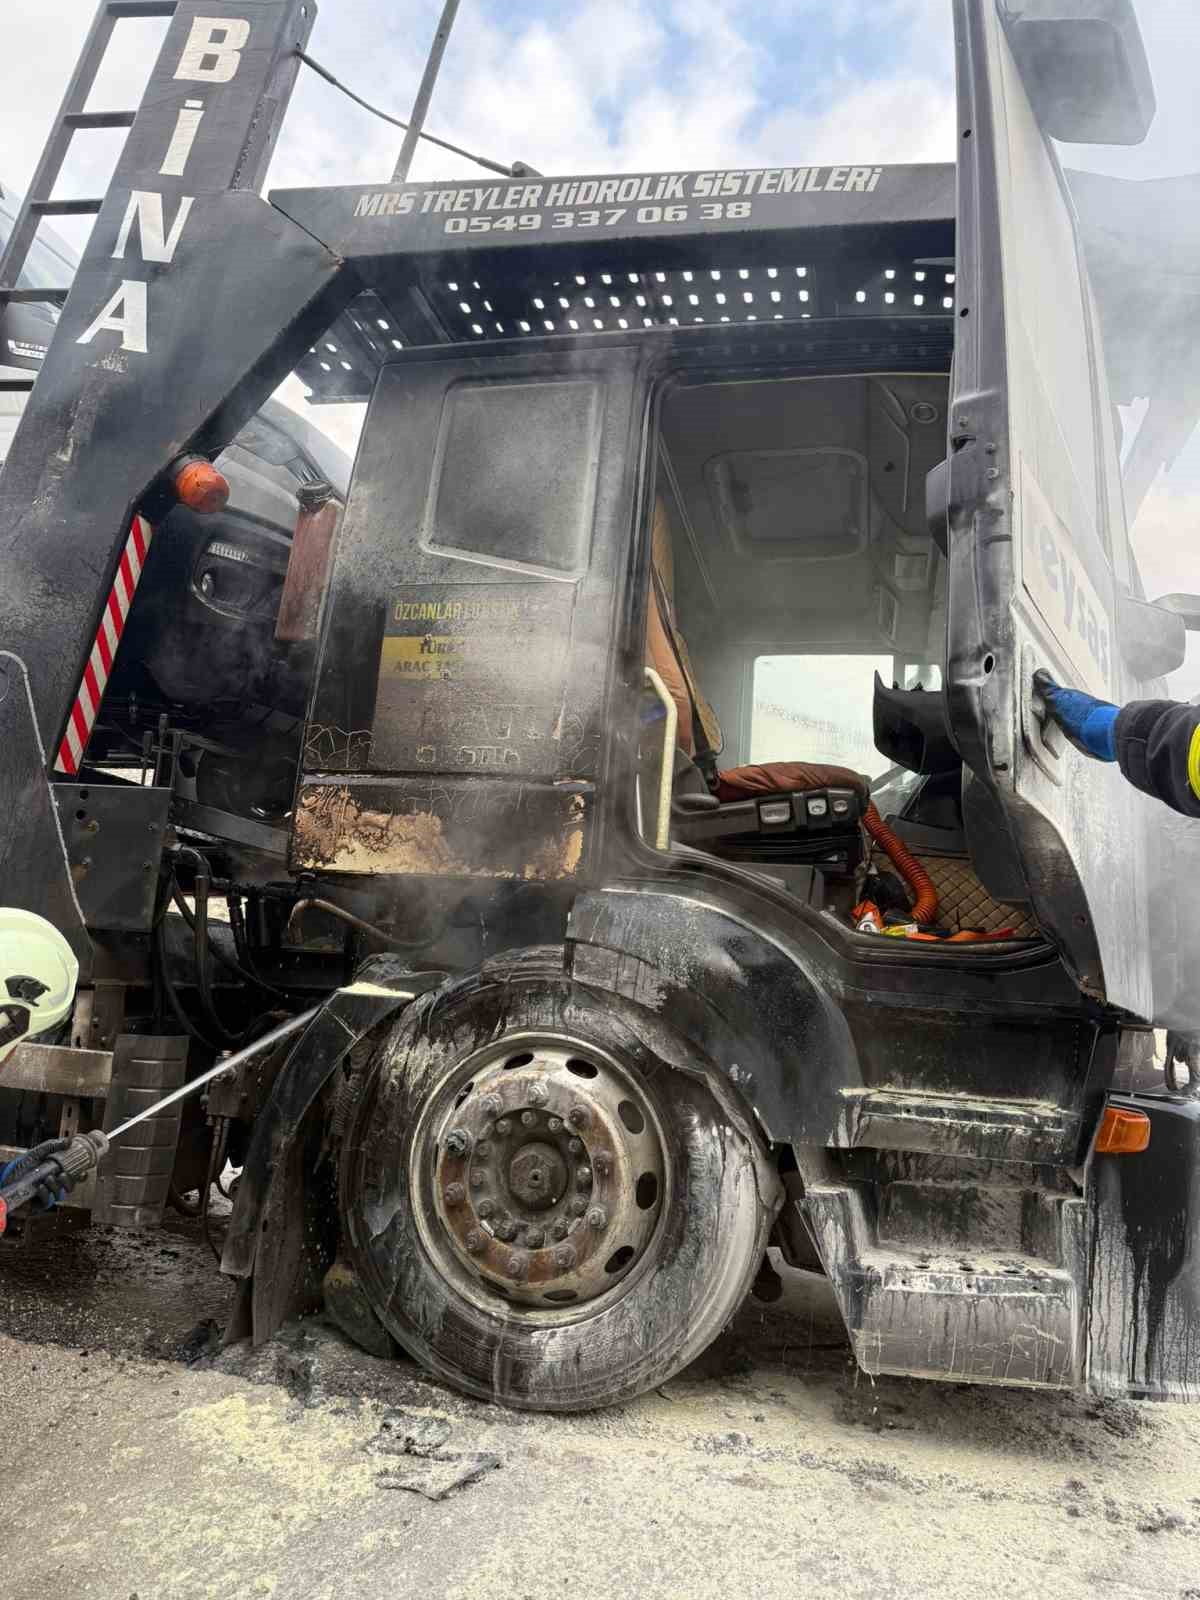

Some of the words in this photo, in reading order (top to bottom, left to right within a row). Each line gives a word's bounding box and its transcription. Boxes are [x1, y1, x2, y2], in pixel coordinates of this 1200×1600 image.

[353, 191, 417, 217] MRS
[420, 184, 543, 214] TREYLER
[444, 213, 543, 233] 0549
[551, 208, 627, 229] 337
[636, 204, 688, 224] 06
[699, 201, 752, 220] 38
